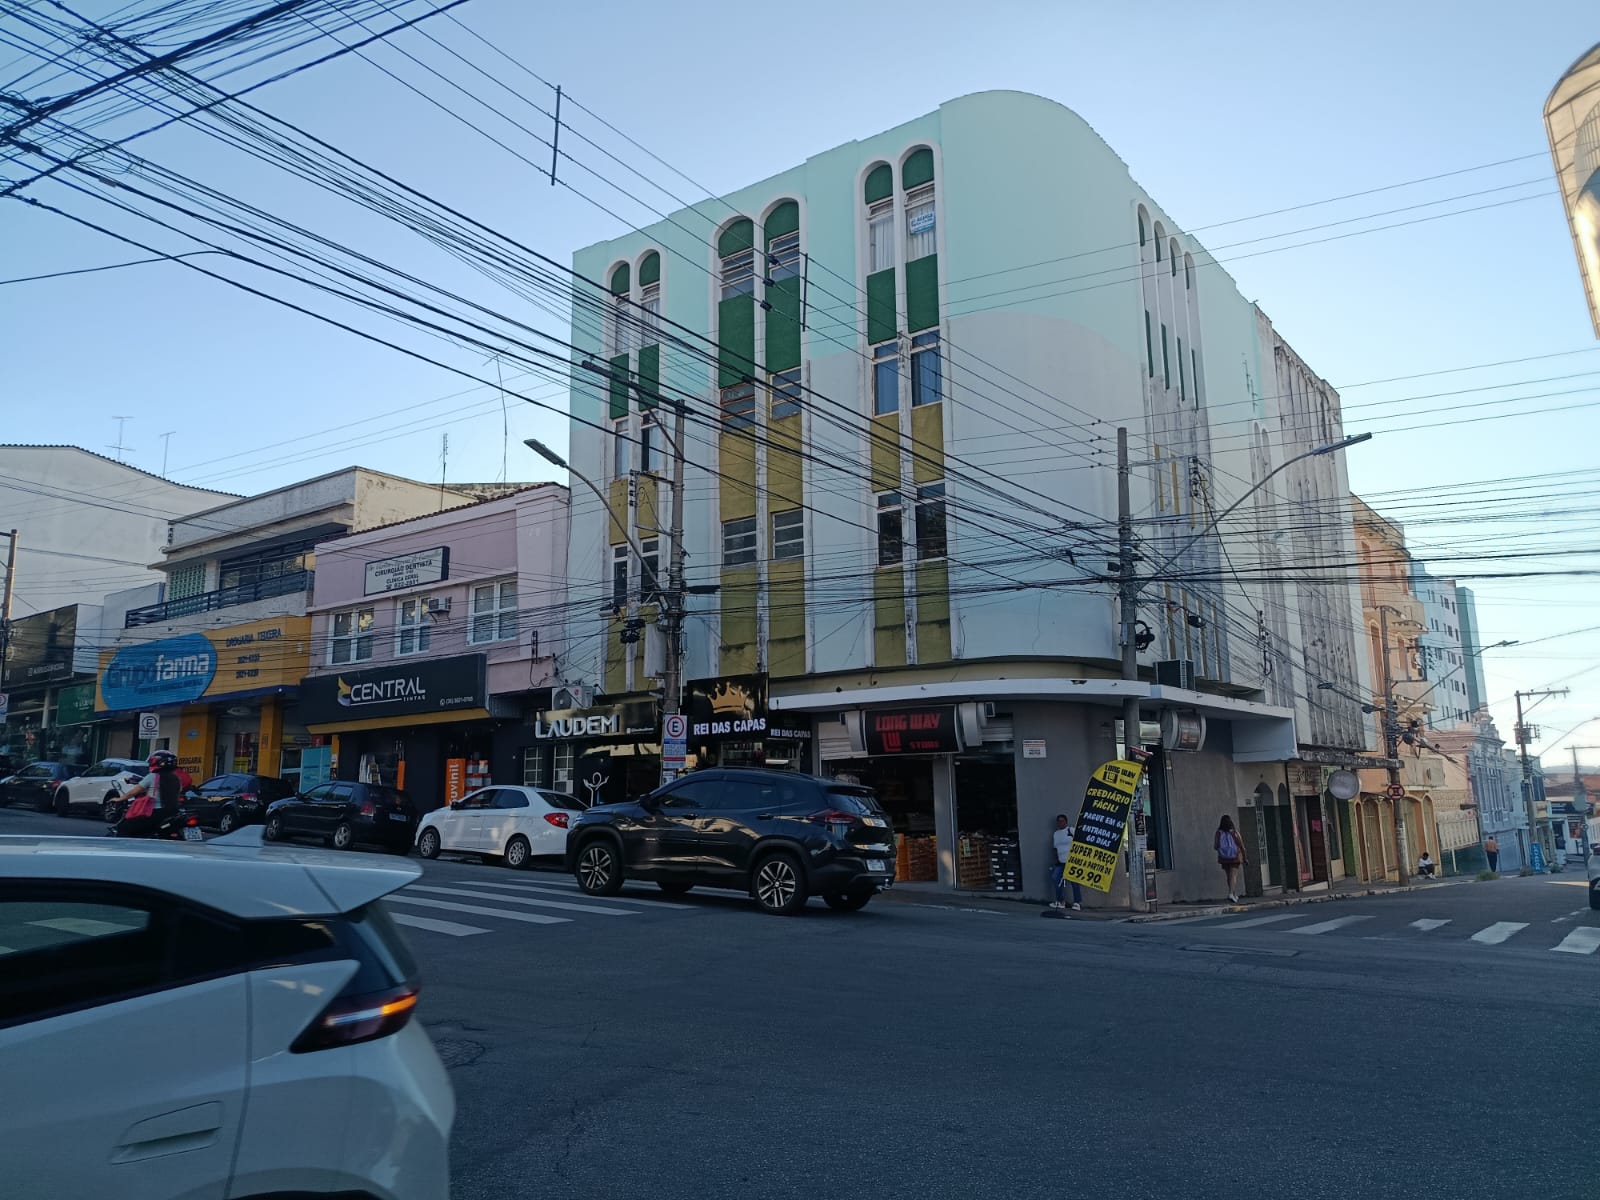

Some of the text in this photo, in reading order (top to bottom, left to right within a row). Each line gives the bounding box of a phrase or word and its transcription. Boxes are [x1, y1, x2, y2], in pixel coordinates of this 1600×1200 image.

[351, 676, 426, 702] CENTRAL
[146, 719, 153, 727] E
[535, 713, 619, 738] LAUDEM
[672, 722, 679, 732] E
[694, 718, 766, 736] REI DAS CAPAS
[875, 712, 941, 732] LONG WAY
[770, 728, 811, 738] REI DAS CAPAS
[1087, 788, 1130, 805] CREDIÁRIO
[1083, 812, 1104, 823] PAGUE
[1105, 817, 1116, 826] EM
[1082, 824, 1110, 838] ENTRADA
[1096, 837, 1111, 847] DIAS
[1070, 843, 1116, 866] SUPER PREÇO
[1068, 856, 1083, 866] JEANS
[1087, 861, 1104, 873] PARTIR
[1069, 866, 1102, 883] 59,90
